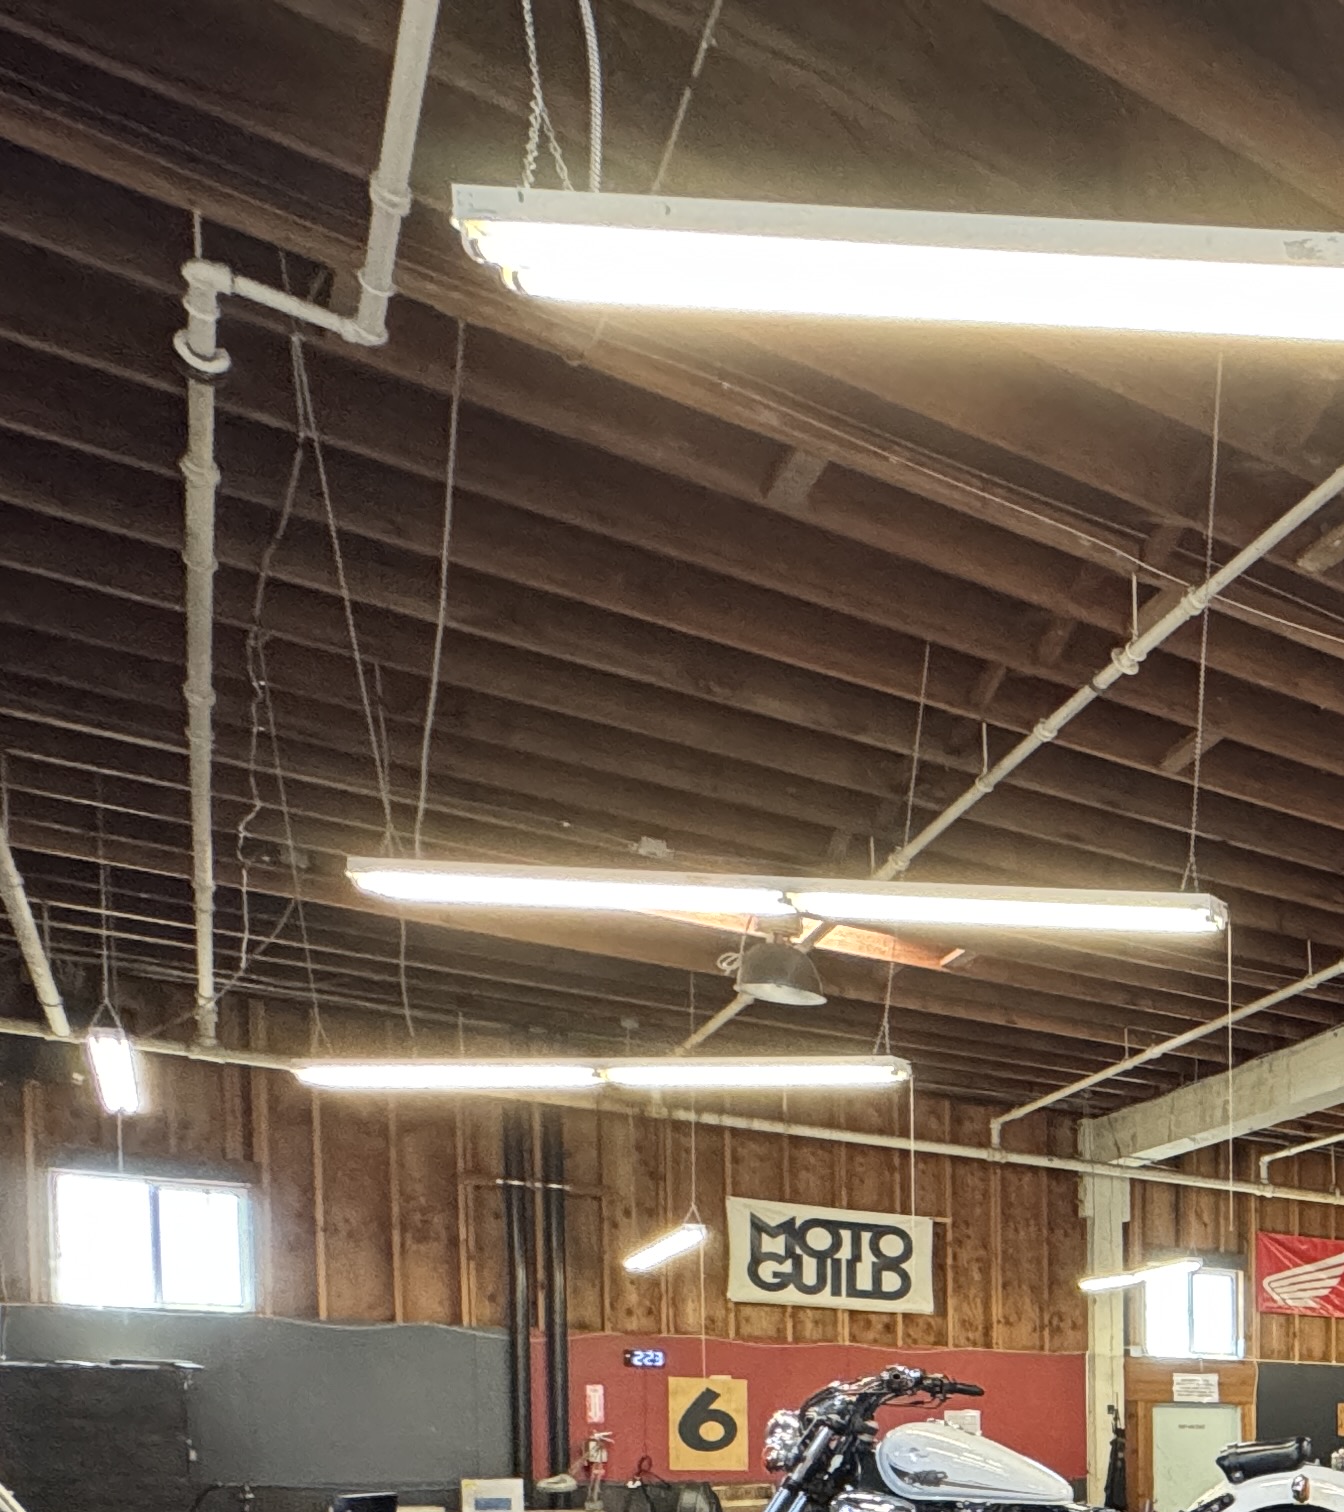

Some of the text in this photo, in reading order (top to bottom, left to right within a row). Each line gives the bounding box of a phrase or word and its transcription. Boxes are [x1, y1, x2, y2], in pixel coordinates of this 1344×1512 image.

[750, 1212, 913, 1266] MOTO
[747, 1252, 912, 1301] GUILD
[678, 1387, 738, 1452] 6
